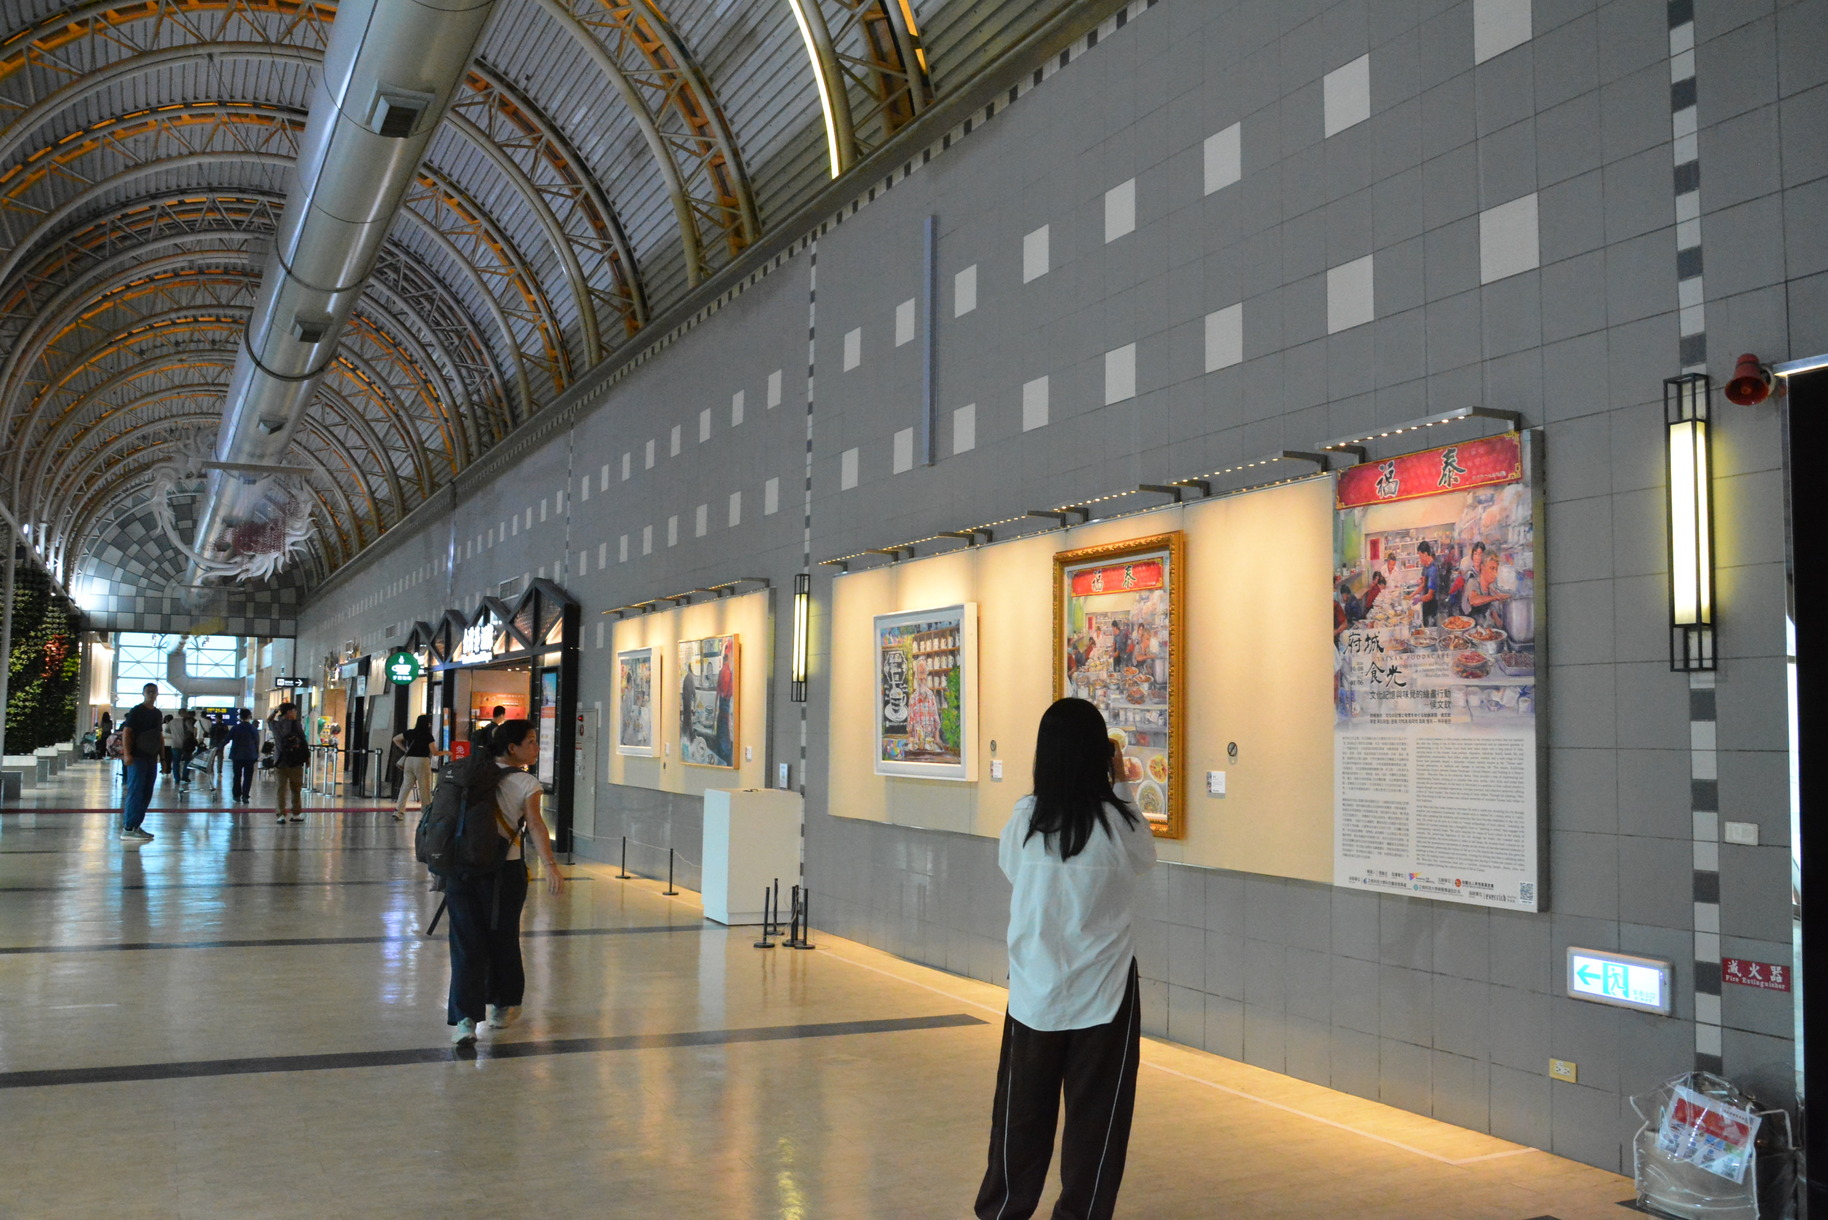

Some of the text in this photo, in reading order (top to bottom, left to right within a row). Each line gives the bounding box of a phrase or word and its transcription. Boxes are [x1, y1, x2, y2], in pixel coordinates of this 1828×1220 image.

[1343, 631, 1384, 655] 府城
[1365, 661, 1407, 688] 食光
[1725, 974, 1786, 989] Fire Extinguisher
[1727, 959, 1783, 983] 滅火器
